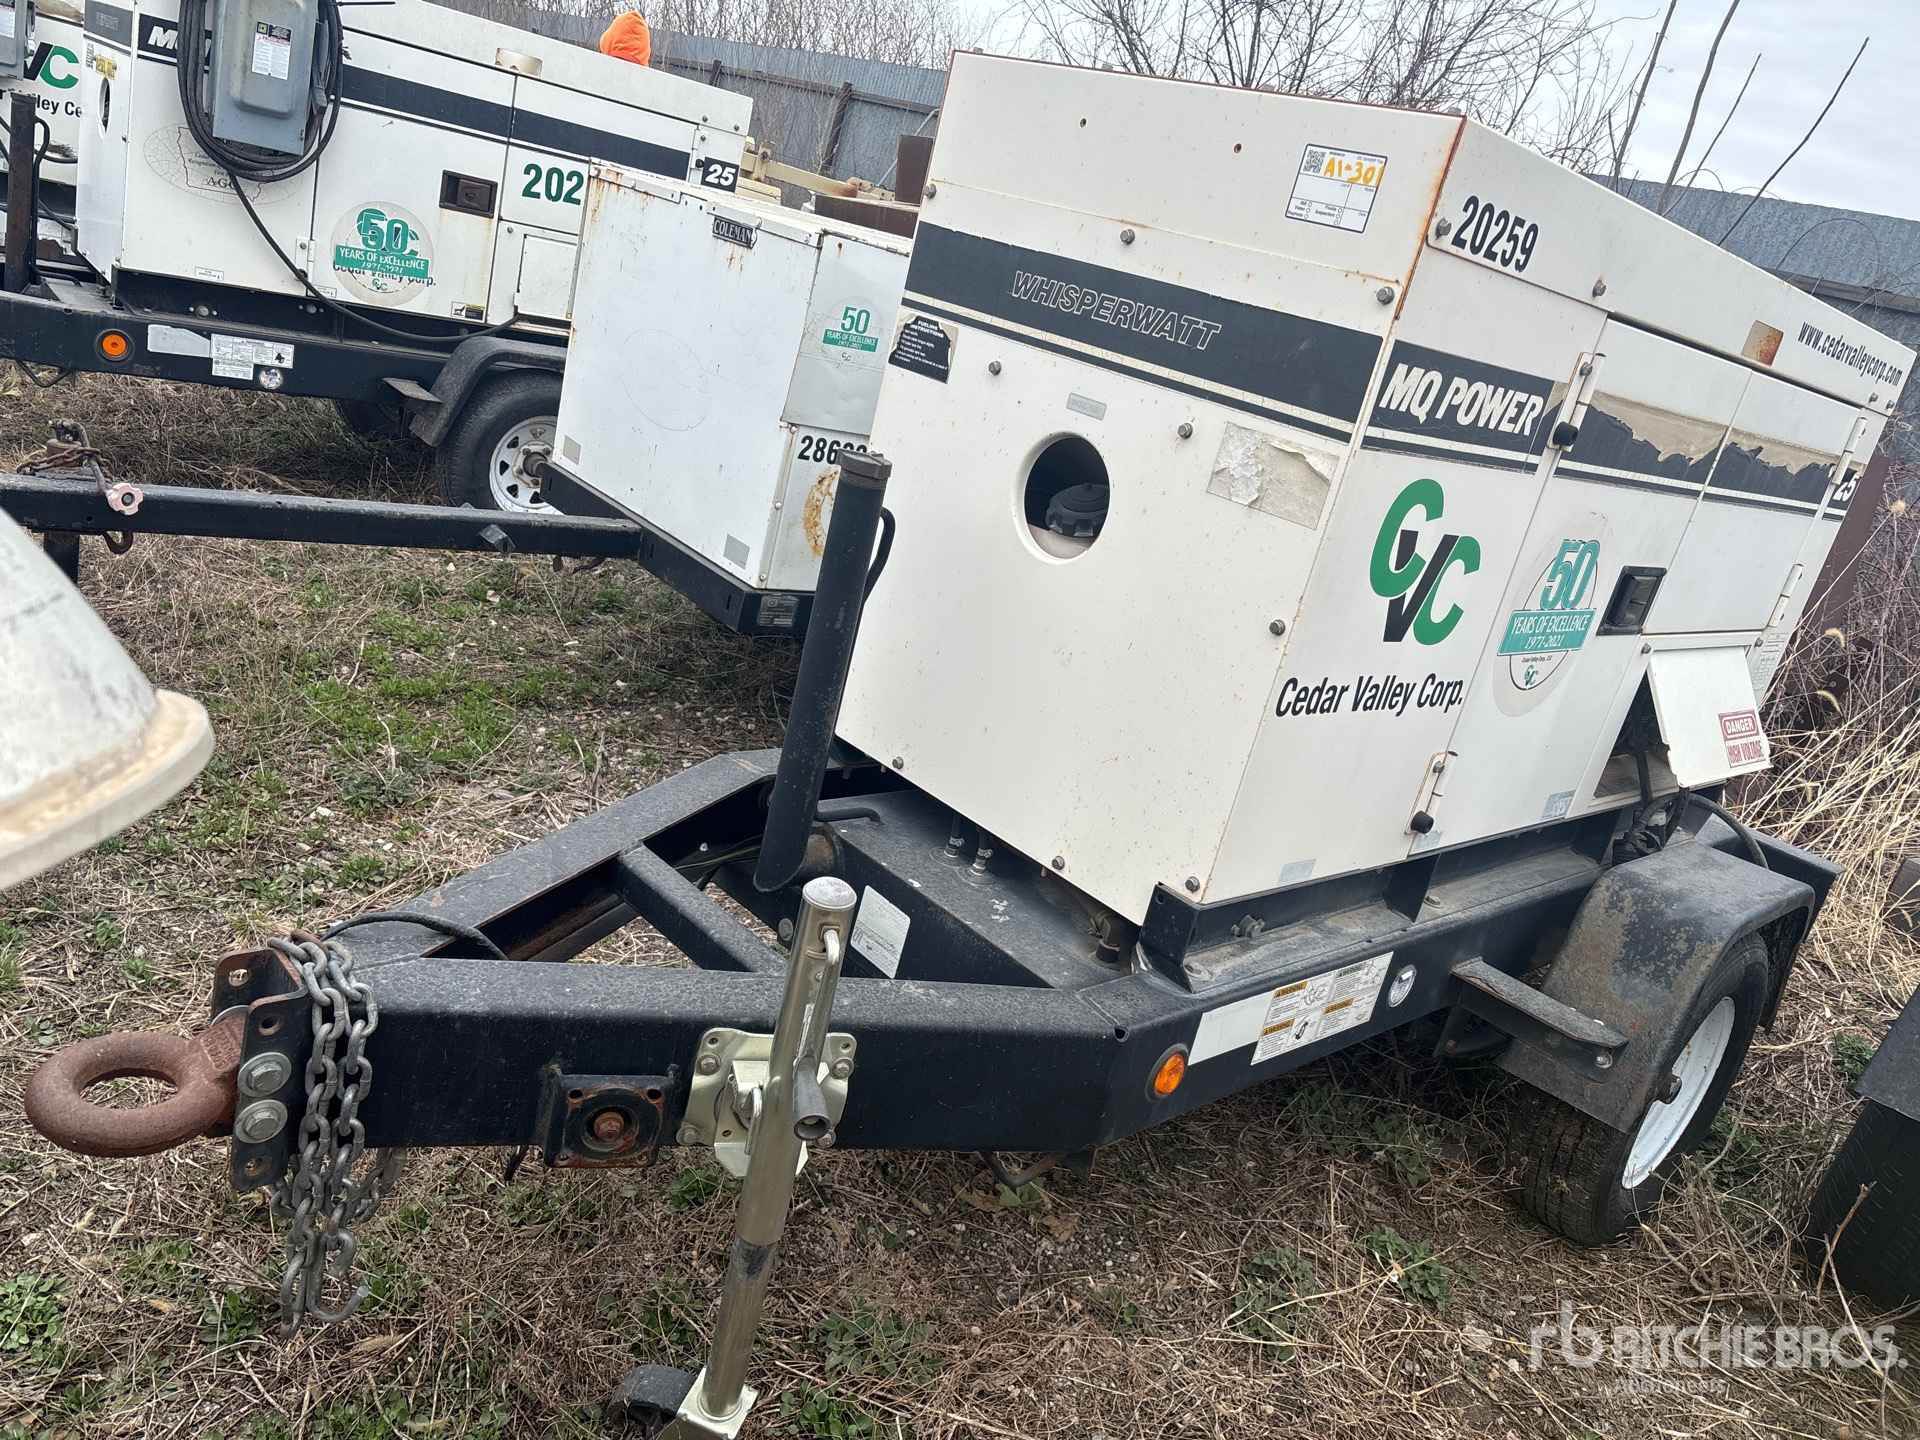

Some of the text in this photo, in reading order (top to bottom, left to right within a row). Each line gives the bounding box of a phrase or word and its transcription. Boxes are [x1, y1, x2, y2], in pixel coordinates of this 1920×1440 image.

[705, 163, 737, 187] 25
[361, 212, 409, 254] 50
[714, 220, 751, 243] COLEMAN
[1451, 195, 1539, 273] 20259
[340, 247, 426, 270] YEARS OF EXCELLENCE
[841, 306, 870, 334] 50
[1012, 270, 1222, 350] WHISPERWATT
[910, 325, 944, 339] INSTRUCTIONS
[917, 320, 938, 331] FUELING
[826, 331, 876, 346] YEARS OF EXCELLENCE
[1797, 322, 1903, 387] www.cedarvalleycorp.com
[1379, 363, 1544, 436] MQ POWER
[1369, 478, 1481, 646] CVC
[1540, 539, 1600, 610] 50
[1511, 614, 1591, 635] YEARS OF EXCELLENCE
[1524, 635, 1565, 650] 1971-2021
[1275, 673, 1464, 717] Cedar Valley Corp.
[1725, 717, 1755, 735] DANGER
[1727, 740, 1765, 764] HIGH VOLTAGE
